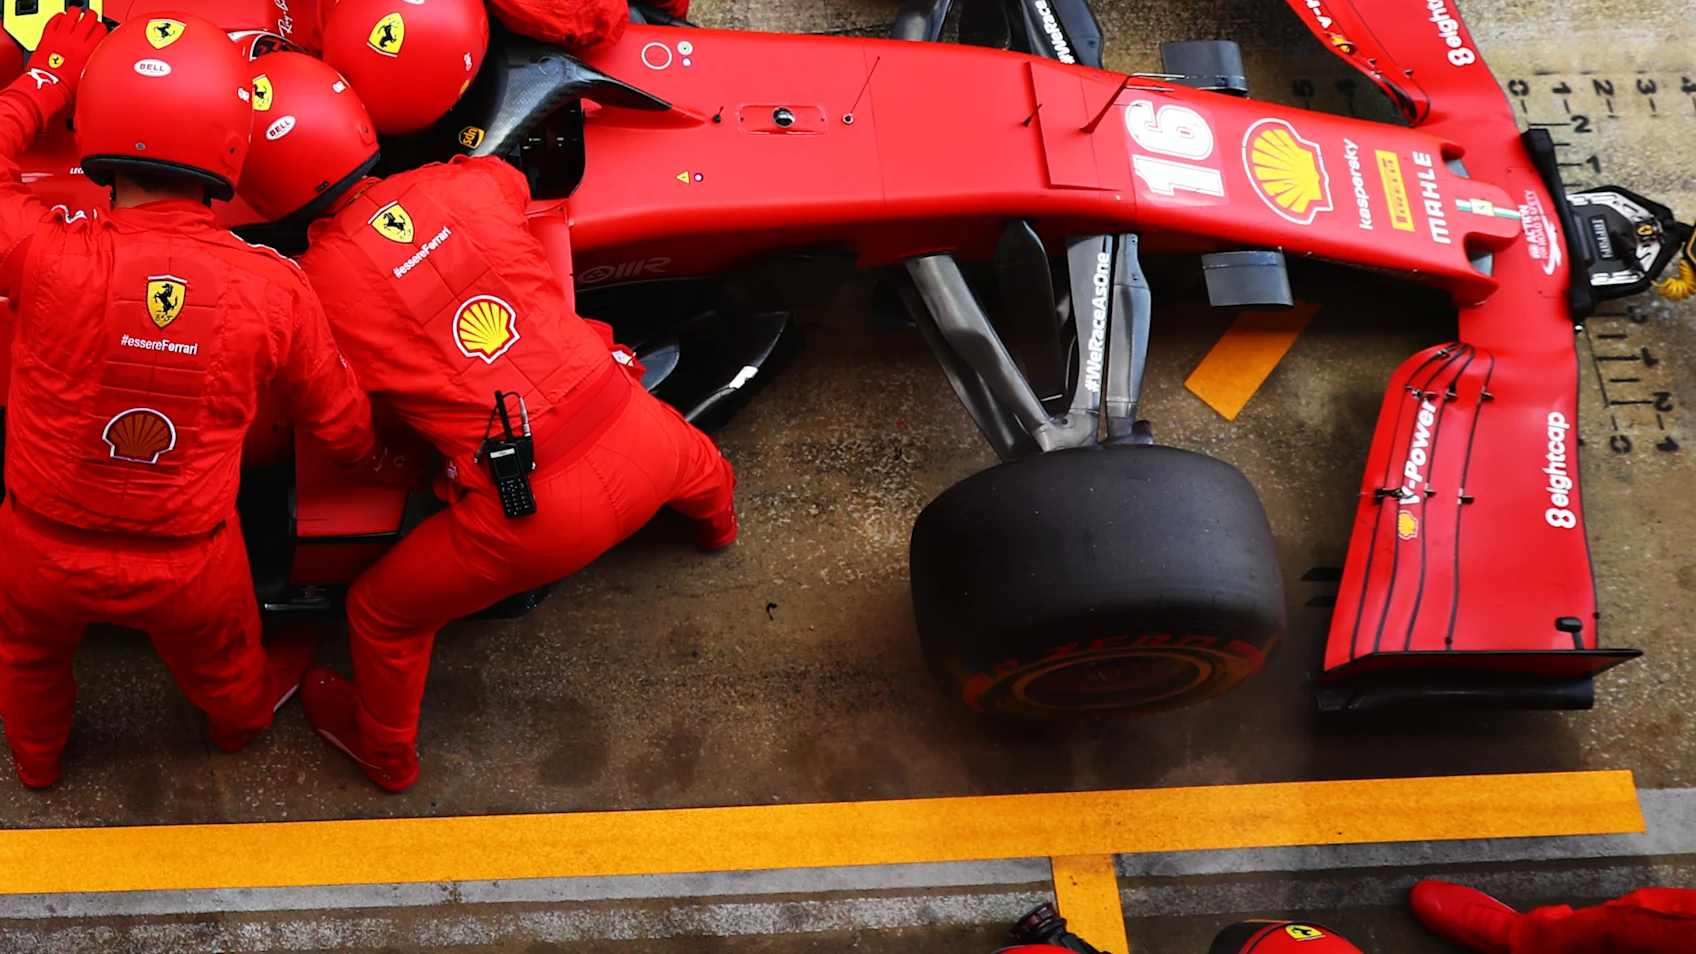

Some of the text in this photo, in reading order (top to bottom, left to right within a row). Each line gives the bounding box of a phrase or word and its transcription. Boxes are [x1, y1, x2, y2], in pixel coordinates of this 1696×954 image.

[139, 62, 166, 73] BELL
[1552, 82, 1572, 95] 1
[1592, 79, 1614, 96] 2
[1636, 78, 1657, 95] 3
[269, 119, 292, 138] BELL
[462, 127, 478, 146] ups
[1570, 114, 1593, 133] 2
[1124, 99, 1226, 198] 16
[1585, 155, 1602, 174] 1
[1343, 138, 1374, 231] kaspersky
[1412, 150, 1451, 244] MAHLE
[1518, 204, 1539, 243] ACTION
[392, 225, 452, 279] #essereFerrari
[1085, 251, 1110, 393] #WeRaceAsOne
[120, 334, 198, 356] #essereFerrari
[1653, 391, 1675, 412] 2
[1399, 399, 1437, 505] V-Power
[1542, 411, 1573, 507] eightcap
